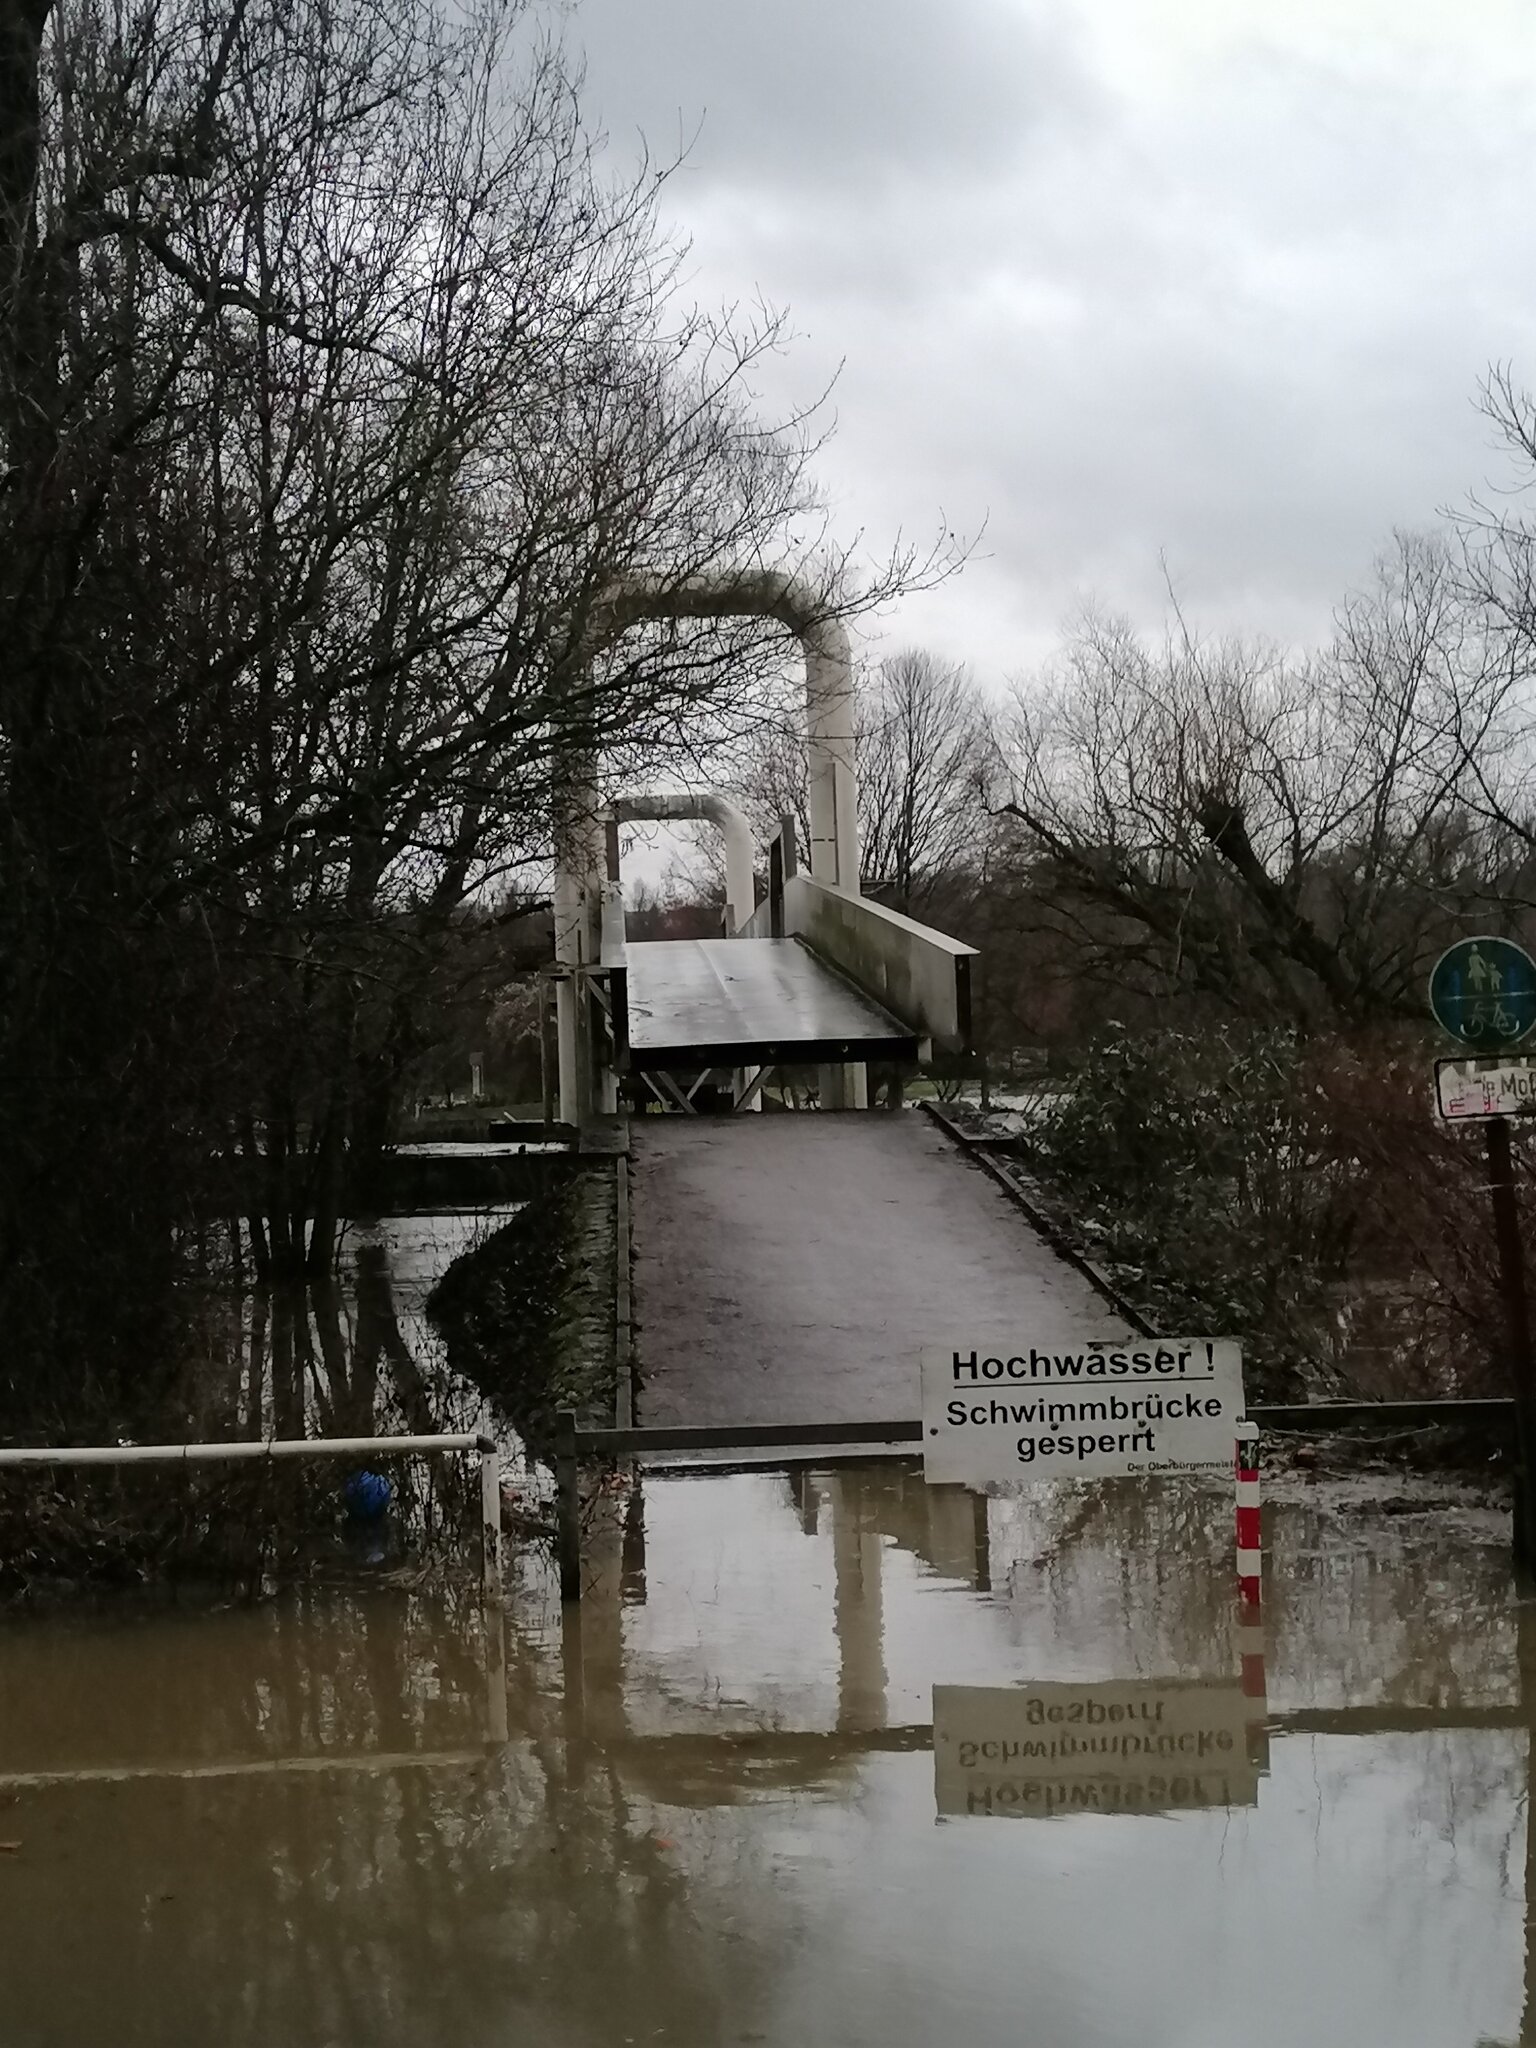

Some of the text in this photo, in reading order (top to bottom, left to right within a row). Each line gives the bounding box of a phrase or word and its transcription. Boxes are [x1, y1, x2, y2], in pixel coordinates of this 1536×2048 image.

[952, 1349, 1192, 1380] Hochwasser
[946, 1393, 1222, 1425] Schwimmbrücke
[1016, 1427, 1156, 1462] gesperrt
